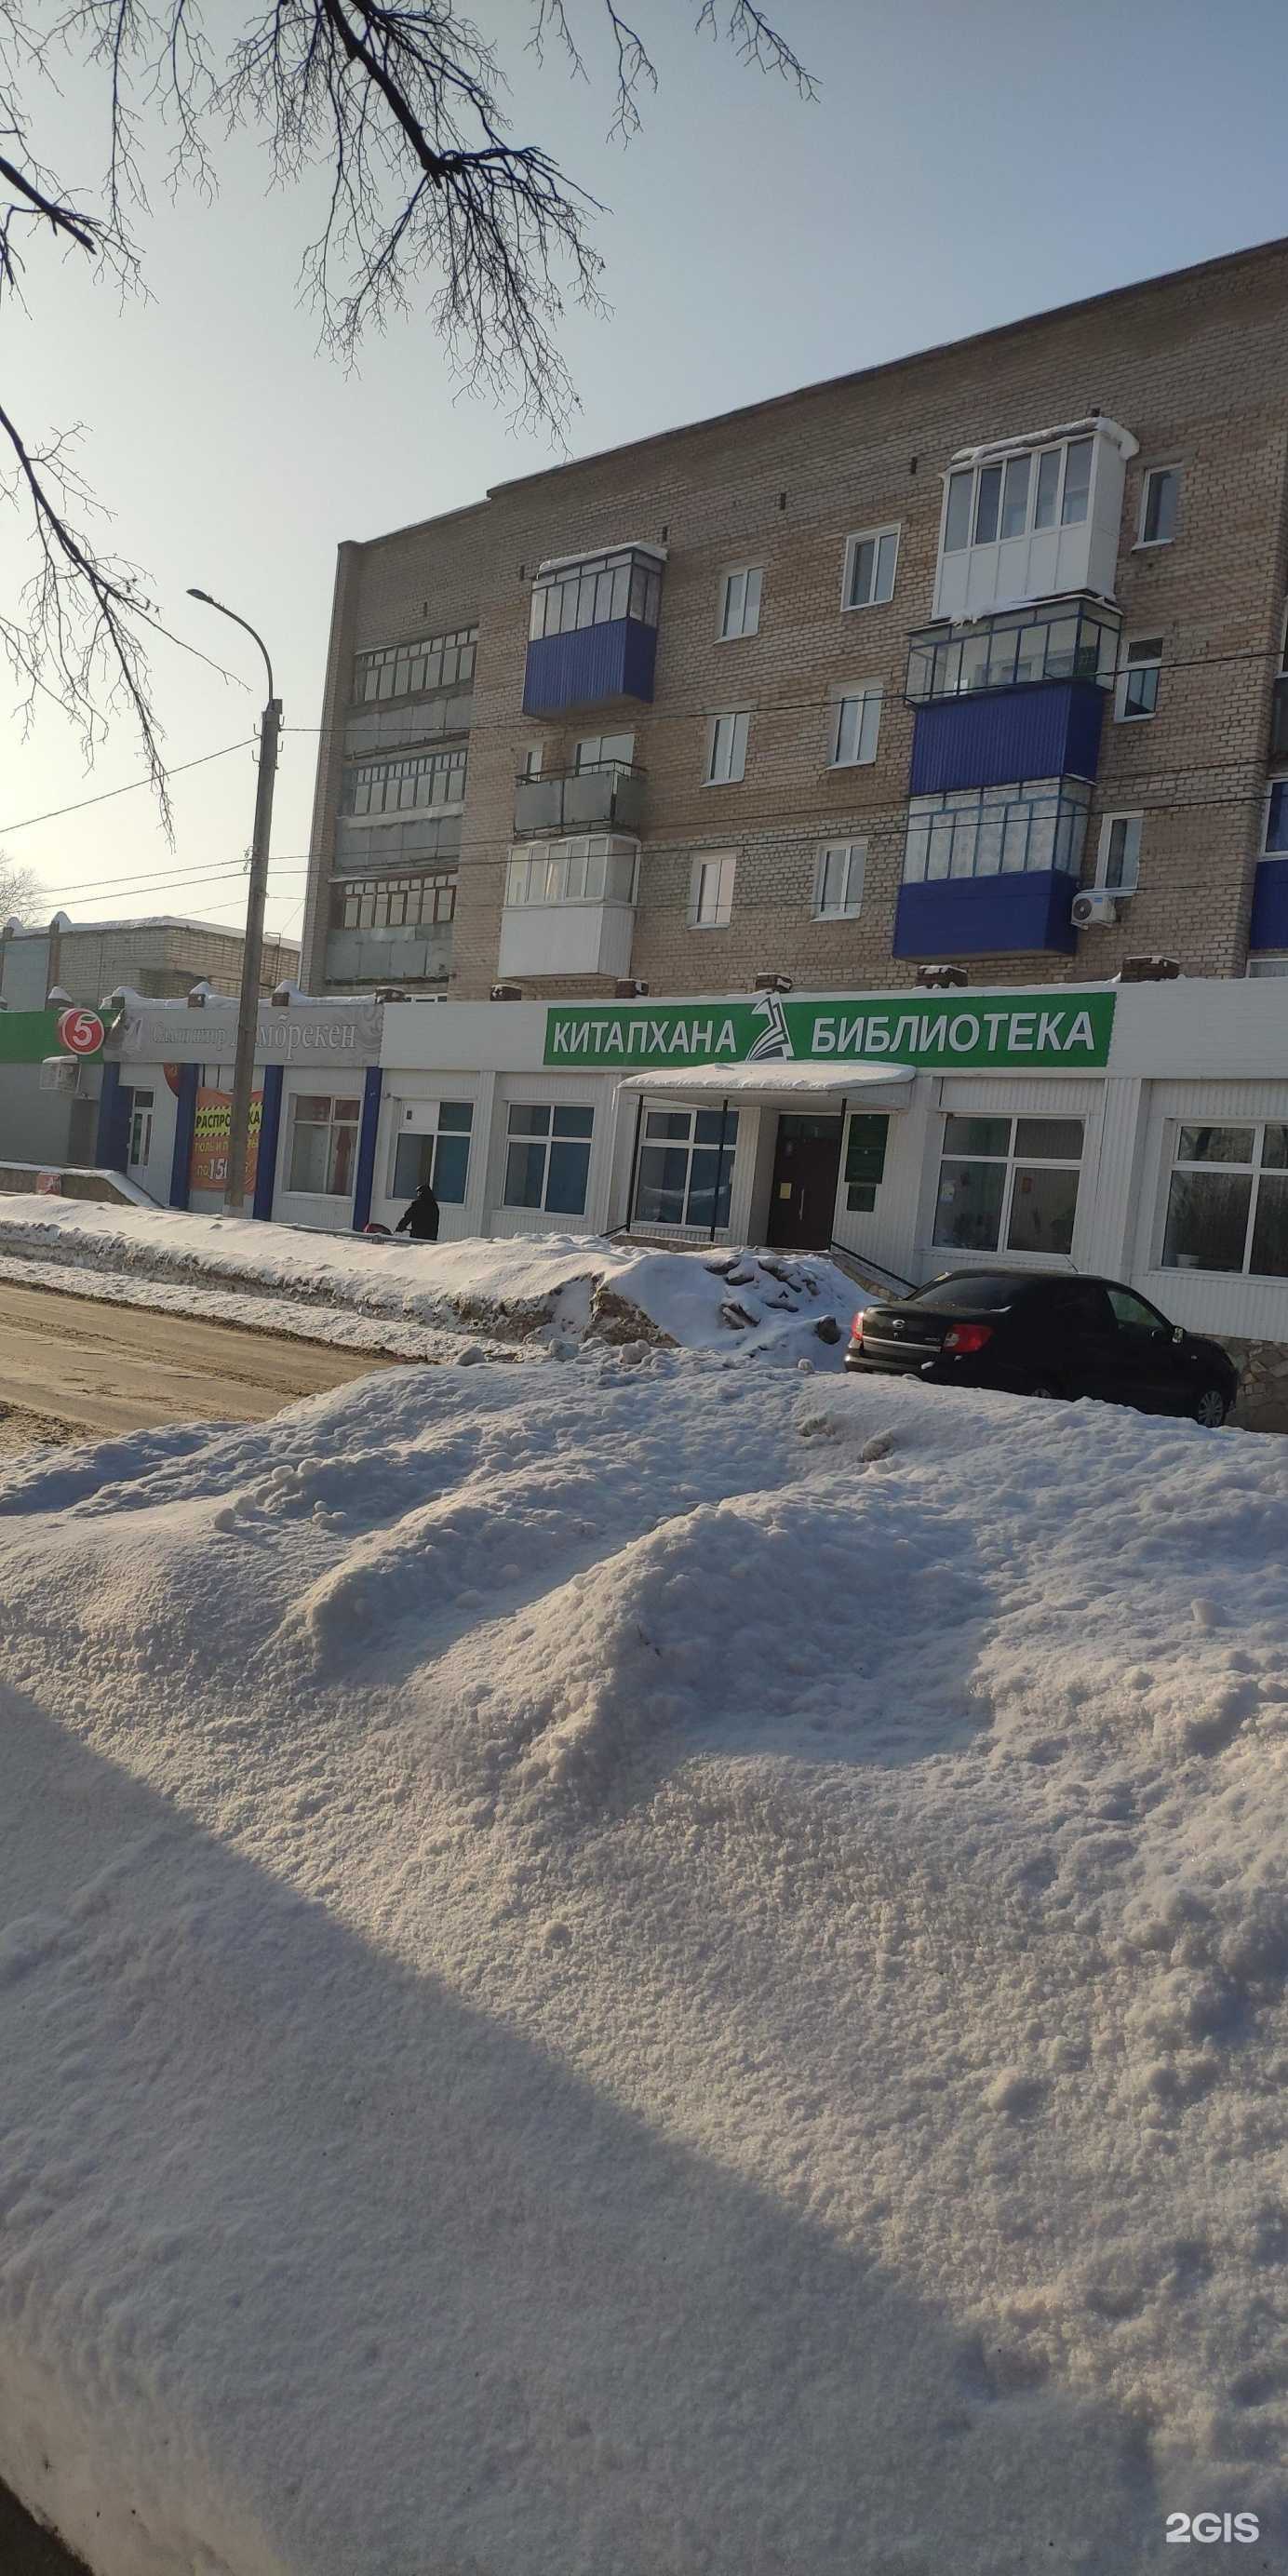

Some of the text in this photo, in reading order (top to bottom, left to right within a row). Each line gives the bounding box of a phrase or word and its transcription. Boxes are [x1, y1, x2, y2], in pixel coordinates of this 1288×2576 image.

[72, 1013, 100, 1046] 5
[230, 1012, 357, 1061] мбрекен
[553, 1011, 1095, 1053] КИТАПХАНА БИБЛИОТЕКА
[195, 1110, 261, 1128] РАСПРОА
